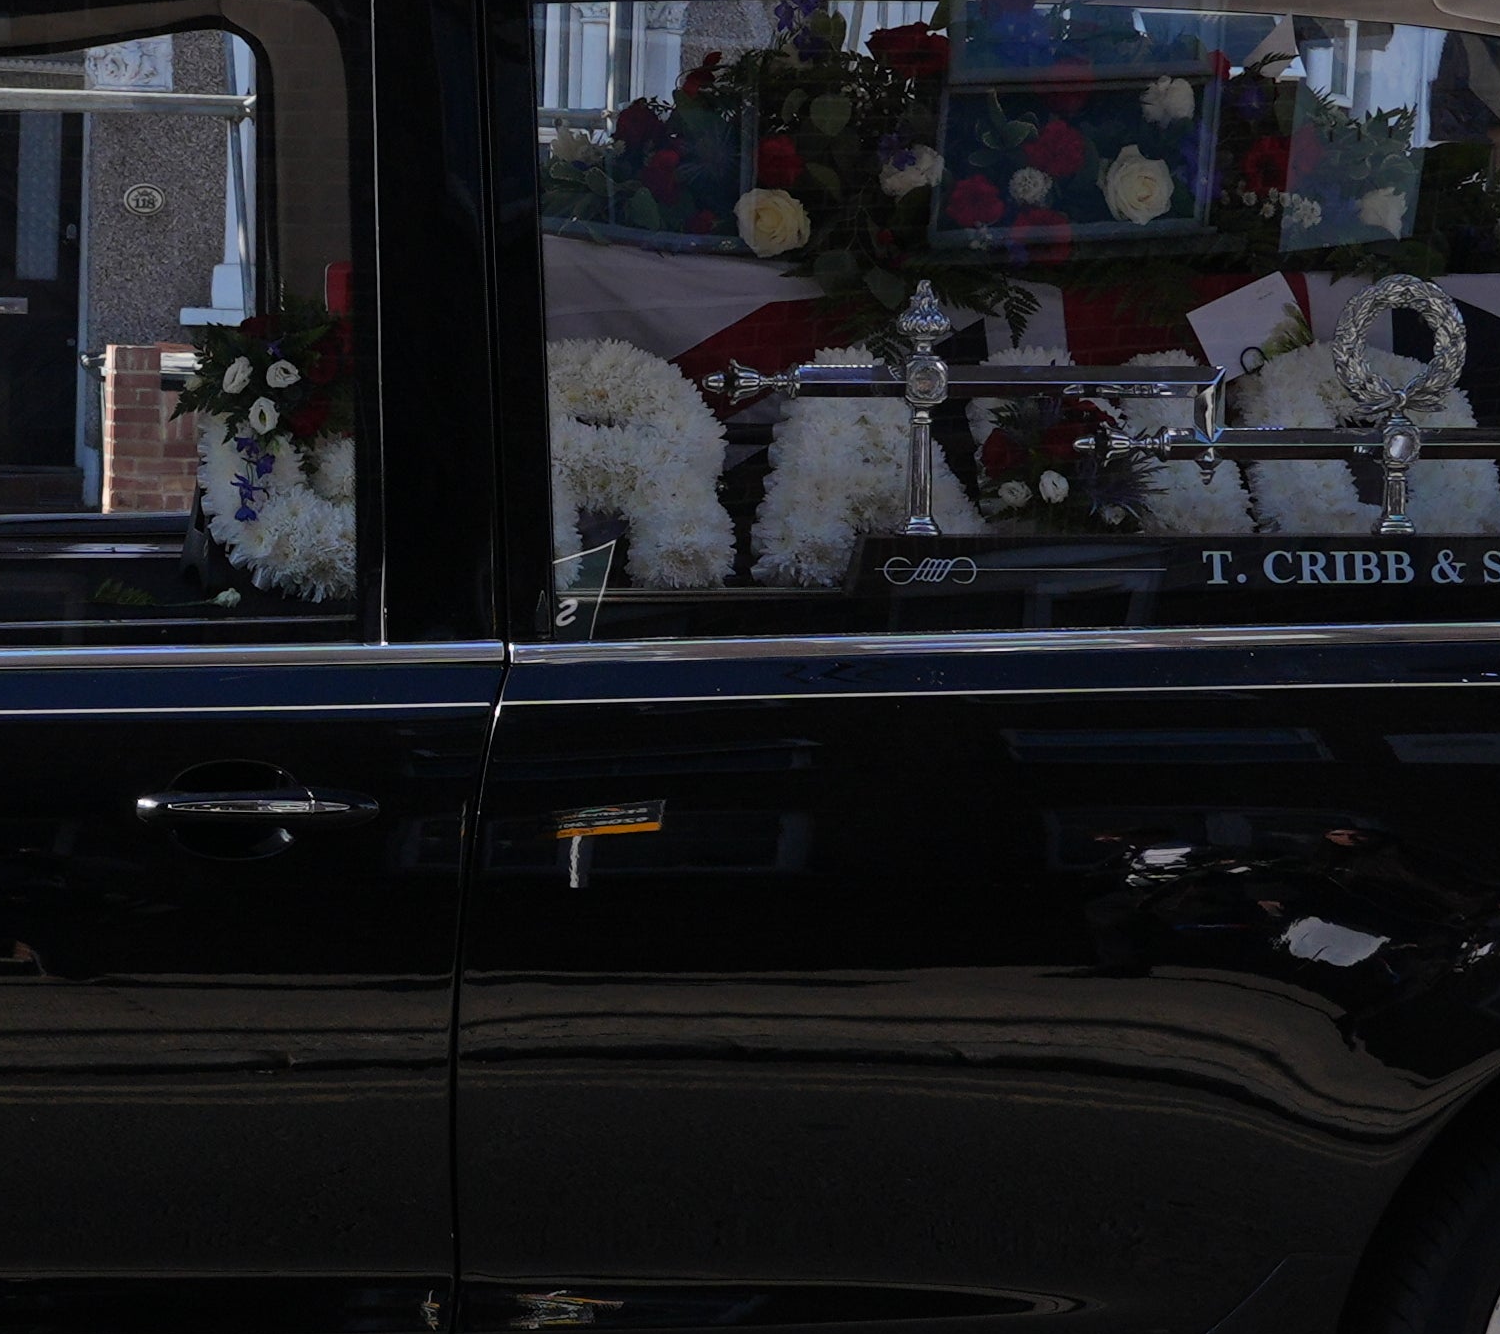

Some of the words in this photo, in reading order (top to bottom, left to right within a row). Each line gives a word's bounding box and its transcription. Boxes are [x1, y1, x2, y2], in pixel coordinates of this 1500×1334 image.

[1202, 550, 1248, 585] T.
[1262, 549, 1416, 585] CRIBB
[1430, 548, 1468, 585] &
